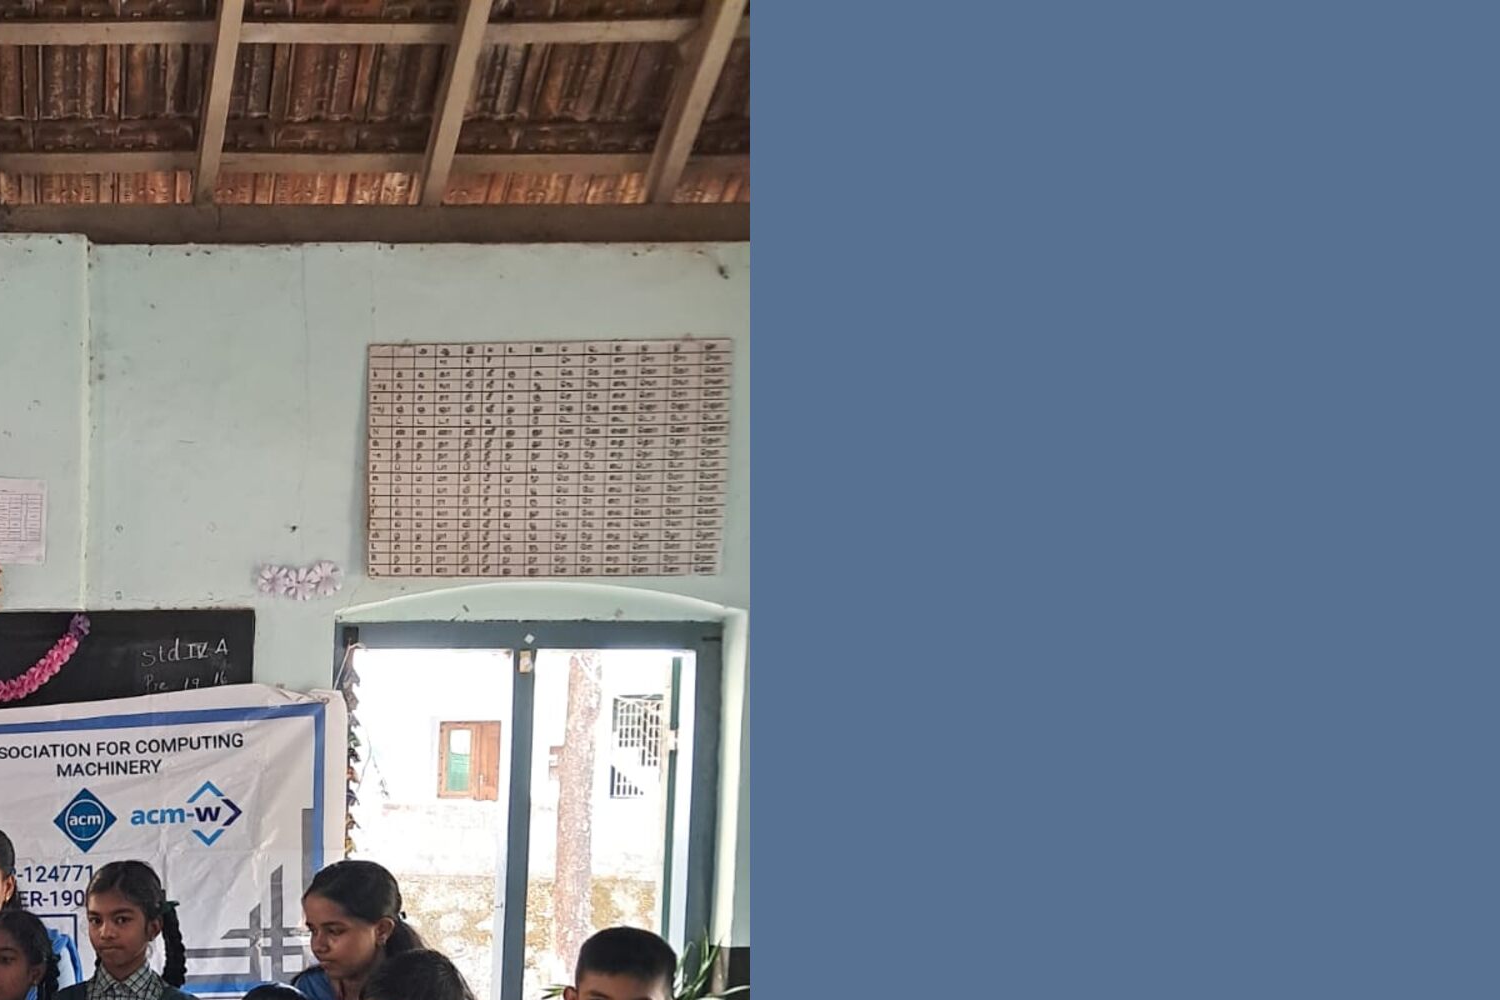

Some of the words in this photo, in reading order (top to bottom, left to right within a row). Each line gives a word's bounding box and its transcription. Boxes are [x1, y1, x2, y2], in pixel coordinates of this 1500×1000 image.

[214, 637, 228, 656] A
[96, 741, 131, 756] FOR
[135, 733, 244, 755] COMPUTING
[56, 759, 163, 777] MACHINERY
[69, 814, 101, 826] acm
